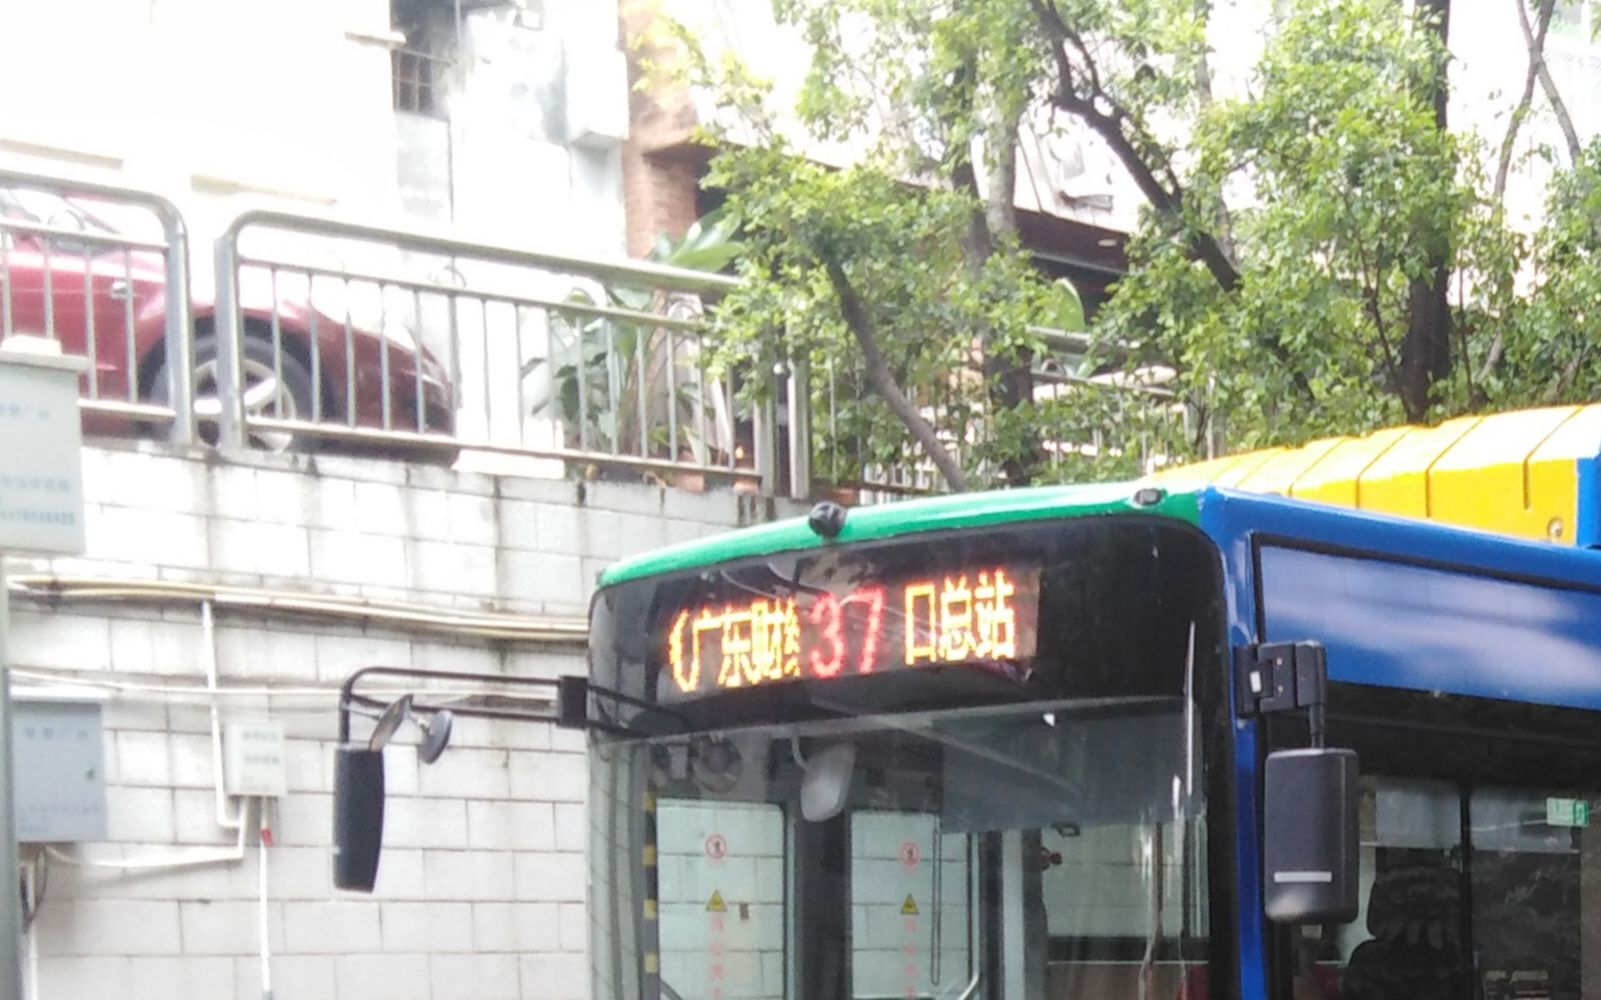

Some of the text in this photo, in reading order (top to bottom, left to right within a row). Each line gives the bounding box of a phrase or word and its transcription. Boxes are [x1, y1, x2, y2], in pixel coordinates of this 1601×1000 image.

[808, 584, 884, 680] 37
[904, 568, 1017, 666] 口总站
